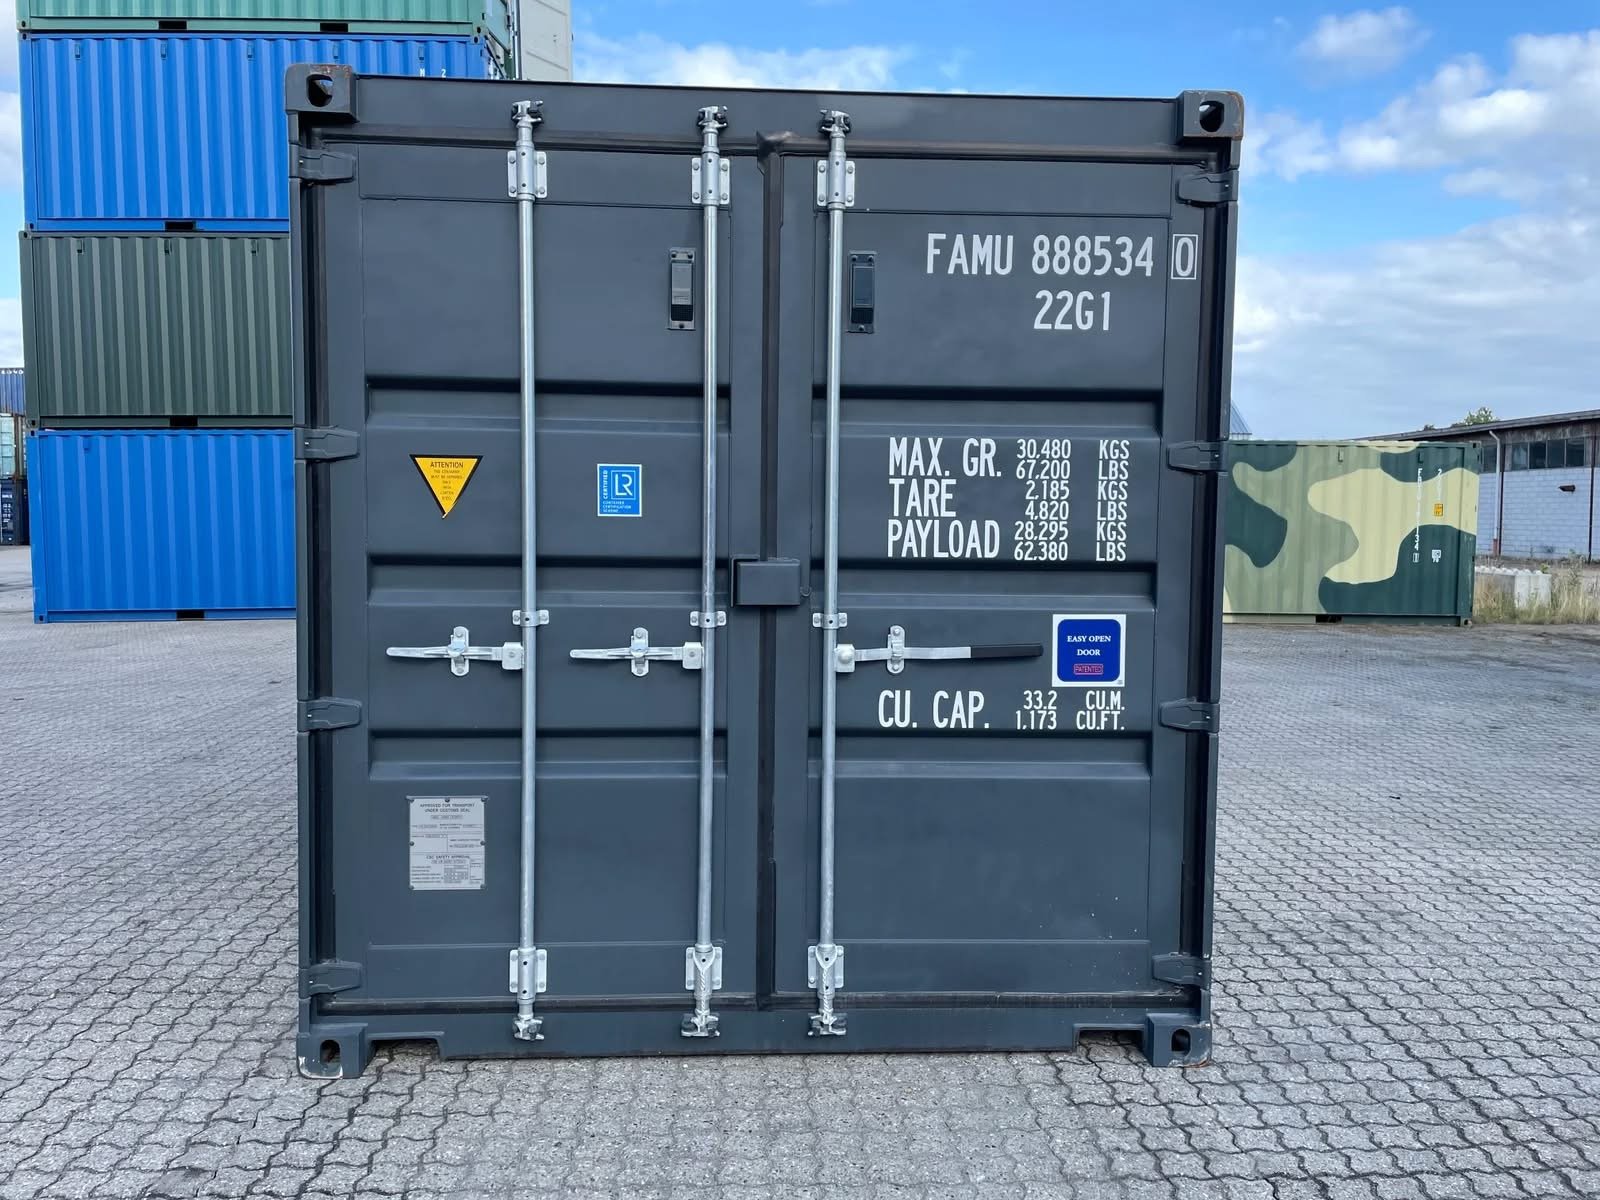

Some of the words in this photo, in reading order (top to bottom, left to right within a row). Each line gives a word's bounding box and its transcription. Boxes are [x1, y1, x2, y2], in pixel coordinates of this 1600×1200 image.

[926, 233, 1014, 276] FAMU
[1031, 234, 1154, 277] 888534
[1174, 236, 1195, 278] 0
[1033, 289, 1111, 331] 22G1
[888, 436, 950, 477] MAX.
[962, 437, 1002, 477] GR.
[1016, 438, 1072, 459] 30,480
[1099, 439, 1130, 460] KGS
[430, 461, 464, 469] ATTENTION
[1015, 459, 1071, 480] 67,200
[1098, 459, 1129, 480] LBS
[615, 473, 633, 496] LR
[1025, 479, 1070, 500] 2,185
[1097, 480, 1129, 501] KGS
[888, 478, 957, 518] TARE
[1024, 500, 1069, 521] 4,820
[1097, 500, 1128, 521] LBS
[887, 518, 1000, 559] PAYLOAD
[1014, 520, 1069, 541] 28,295
[1096, 521, 1127, 542] KGS
[1013, 541, 1068, 561] 62,380
[1095, 541, 1127, 562] LBS
[1067, 635, 1088, 643] EASY
[1088, 635, 1111, 643] OPEN
[1076, 648, 1101, 656] DOOR
[1075, 665, 1102, 673] PATENTED
[878, 689, 918, 729] CU.
[932, 690, 990, 729] CAP.
[1023, 689, 1058, 710] 33.2
[1085, 690, 1125, 711] CU.M.
[1015, 710, 1057, 730] 1,173
[1076, 710, 1125, 731] CU.FT.
